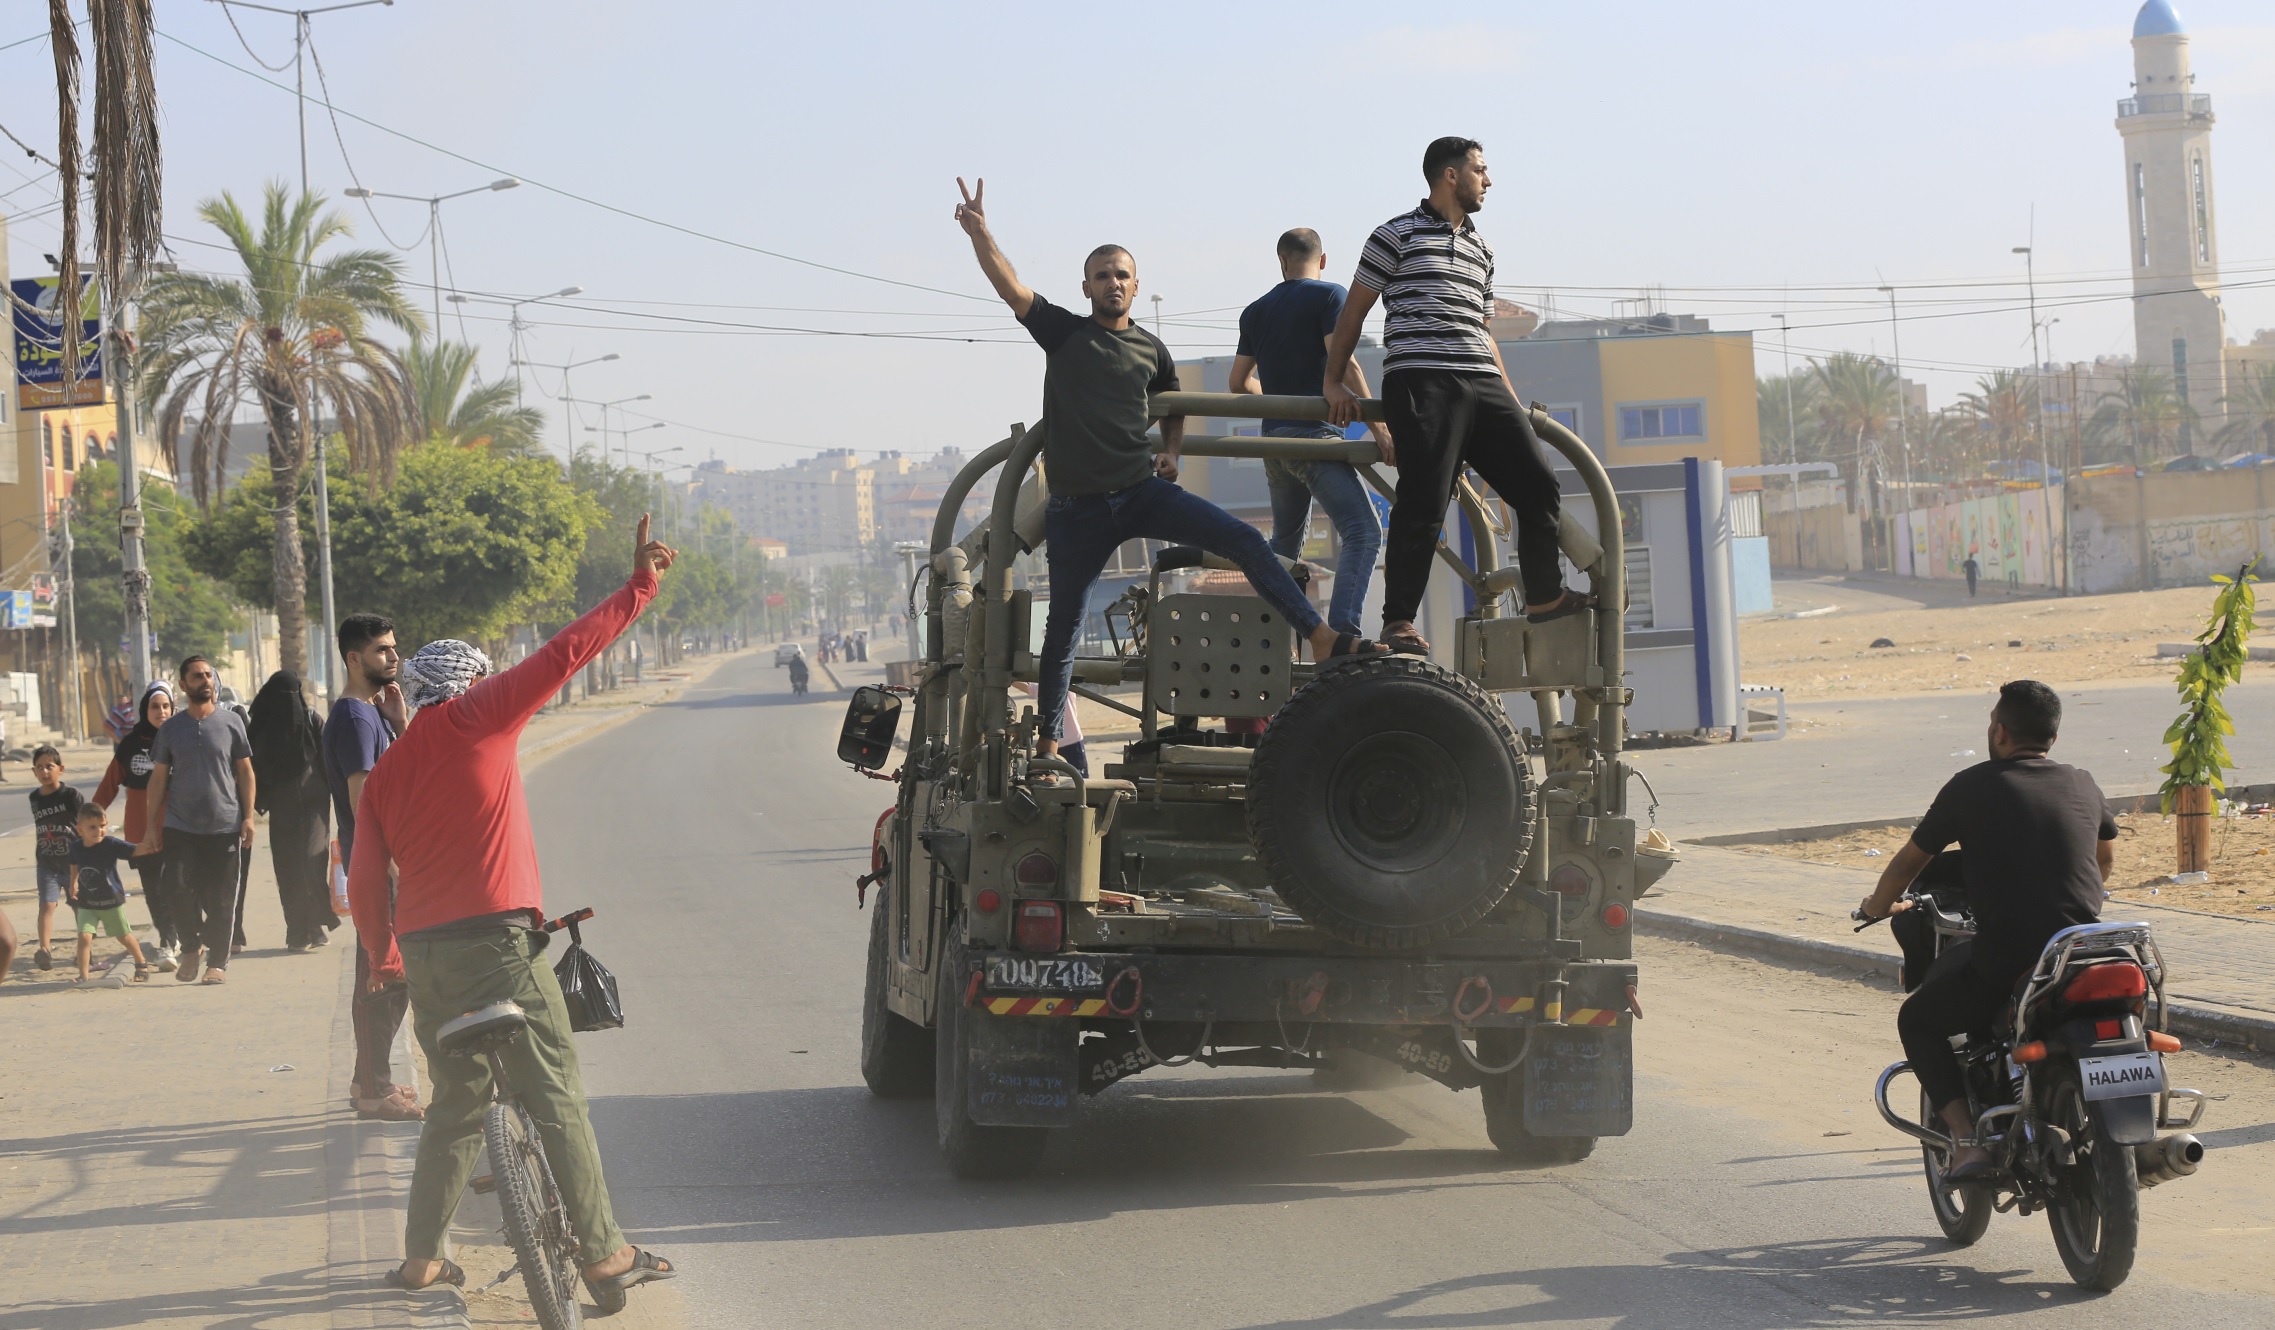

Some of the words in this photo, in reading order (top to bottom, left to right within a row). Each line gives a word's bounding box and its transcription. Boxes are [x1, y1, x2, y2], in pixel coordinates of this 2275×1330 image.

[38, 836, 70, 856] 23
[1397, 1041, 1450, 1073] 40-80
[2088, 1066, 2155, 1086] HALAWA
